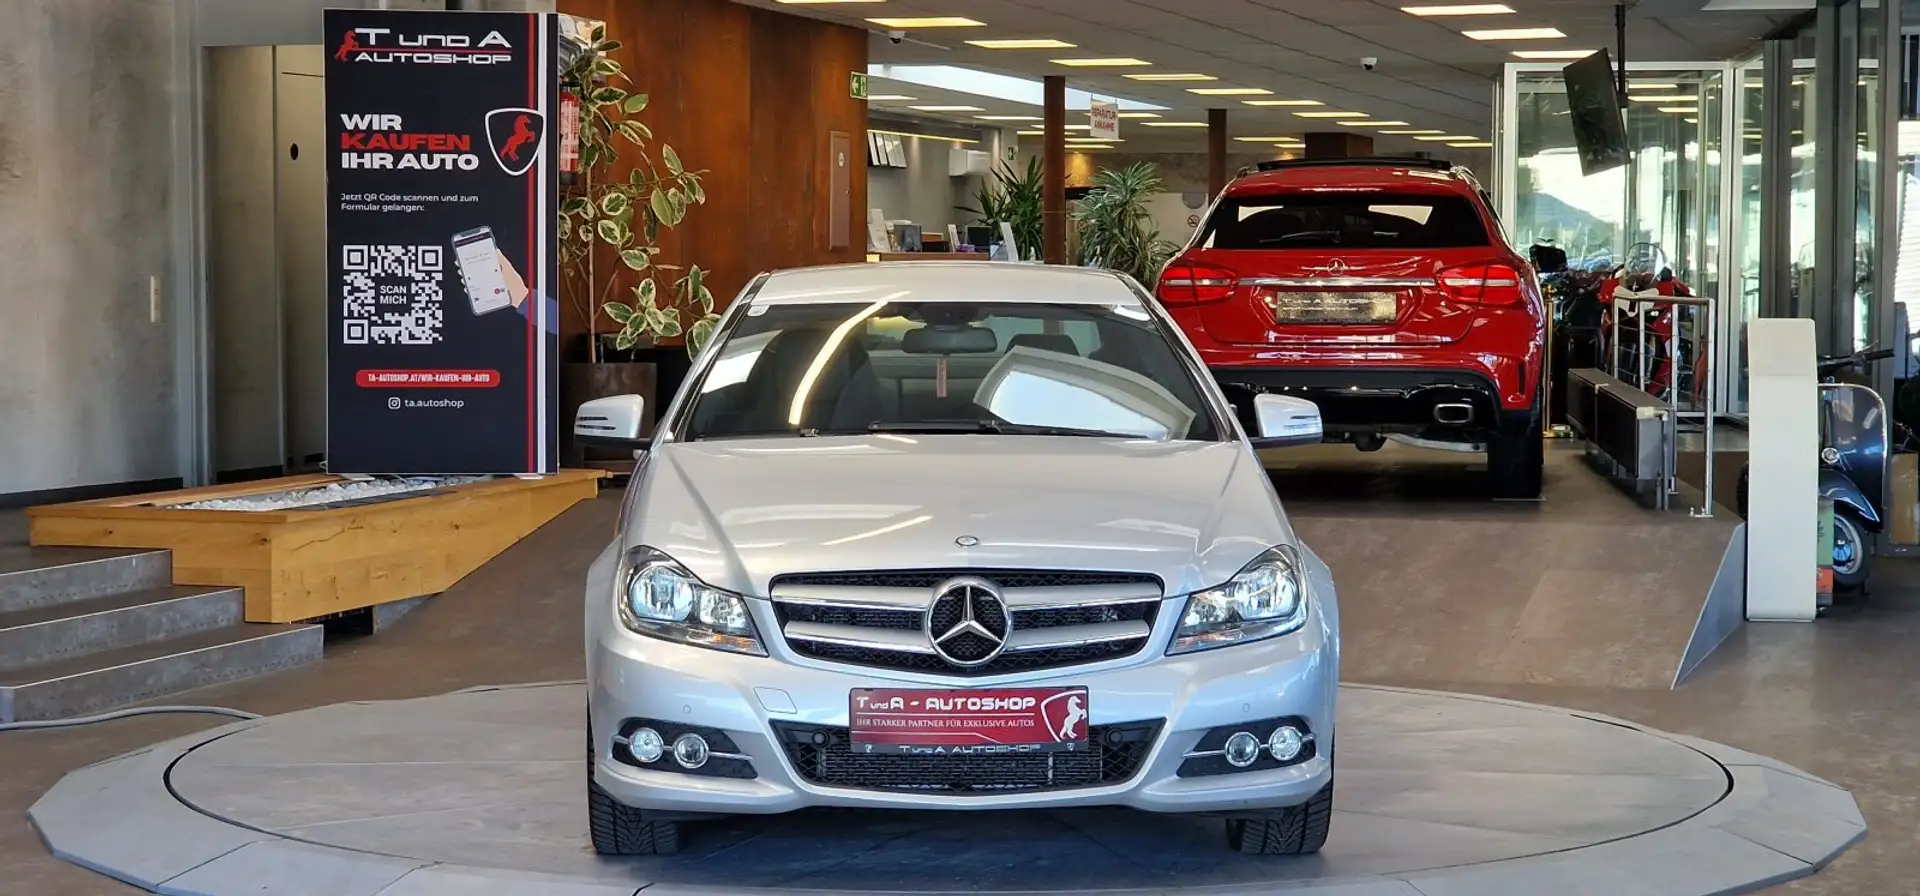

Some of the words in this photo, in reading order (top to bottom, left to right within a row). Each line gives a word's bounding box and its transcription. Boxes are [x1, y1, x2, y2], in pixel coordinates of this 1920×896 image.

[355, 27, 390, 46] T
[477, 30, 512, 48] A
[355, 52, 512, 65] AUTOSHOP
[340, 113, 403, 131] WIR
[340, 132, 471, 151] KAUFEN
[341, 152, 394, 170] IHR
[398, 153, 480, 171] AUTO
[340, 192, 363, 201] Jetzt
[363, 193, 378, 202] QR
[379, 193, 401, 202] Code
[402, 194, 440, 202] scannen
[440, 194, 459, 202] und
[340, 202, 381, 211] Formular
[381, 203, 425, 212] gelangen:
[379, 285, 407, 295] SCAN
[379, 295, 407, 305] MICH
[404, 398, 465, 409] ta.autoshop
[856, 696, 870, 708] T
[870, 700, 889, 710] und
[890, 697, 904, 710] A
[925, 697, 1037, 711] AUTOSHOP
[856, 718, 872, 727] IHR
[872, 718, 908, 727] STARKER
[908, 719, 944, 728] PARTNER
[945, 717, 963, 728] FÜR
[963, 718, 1006, 728] EXKLUSIVE
[1006, 718, 1035, 728] AUTOS
[899, 744, 911, 754] T
[934, 745, 946, 754] A
[952, 744, 1042, 754] AUTOSHOP
